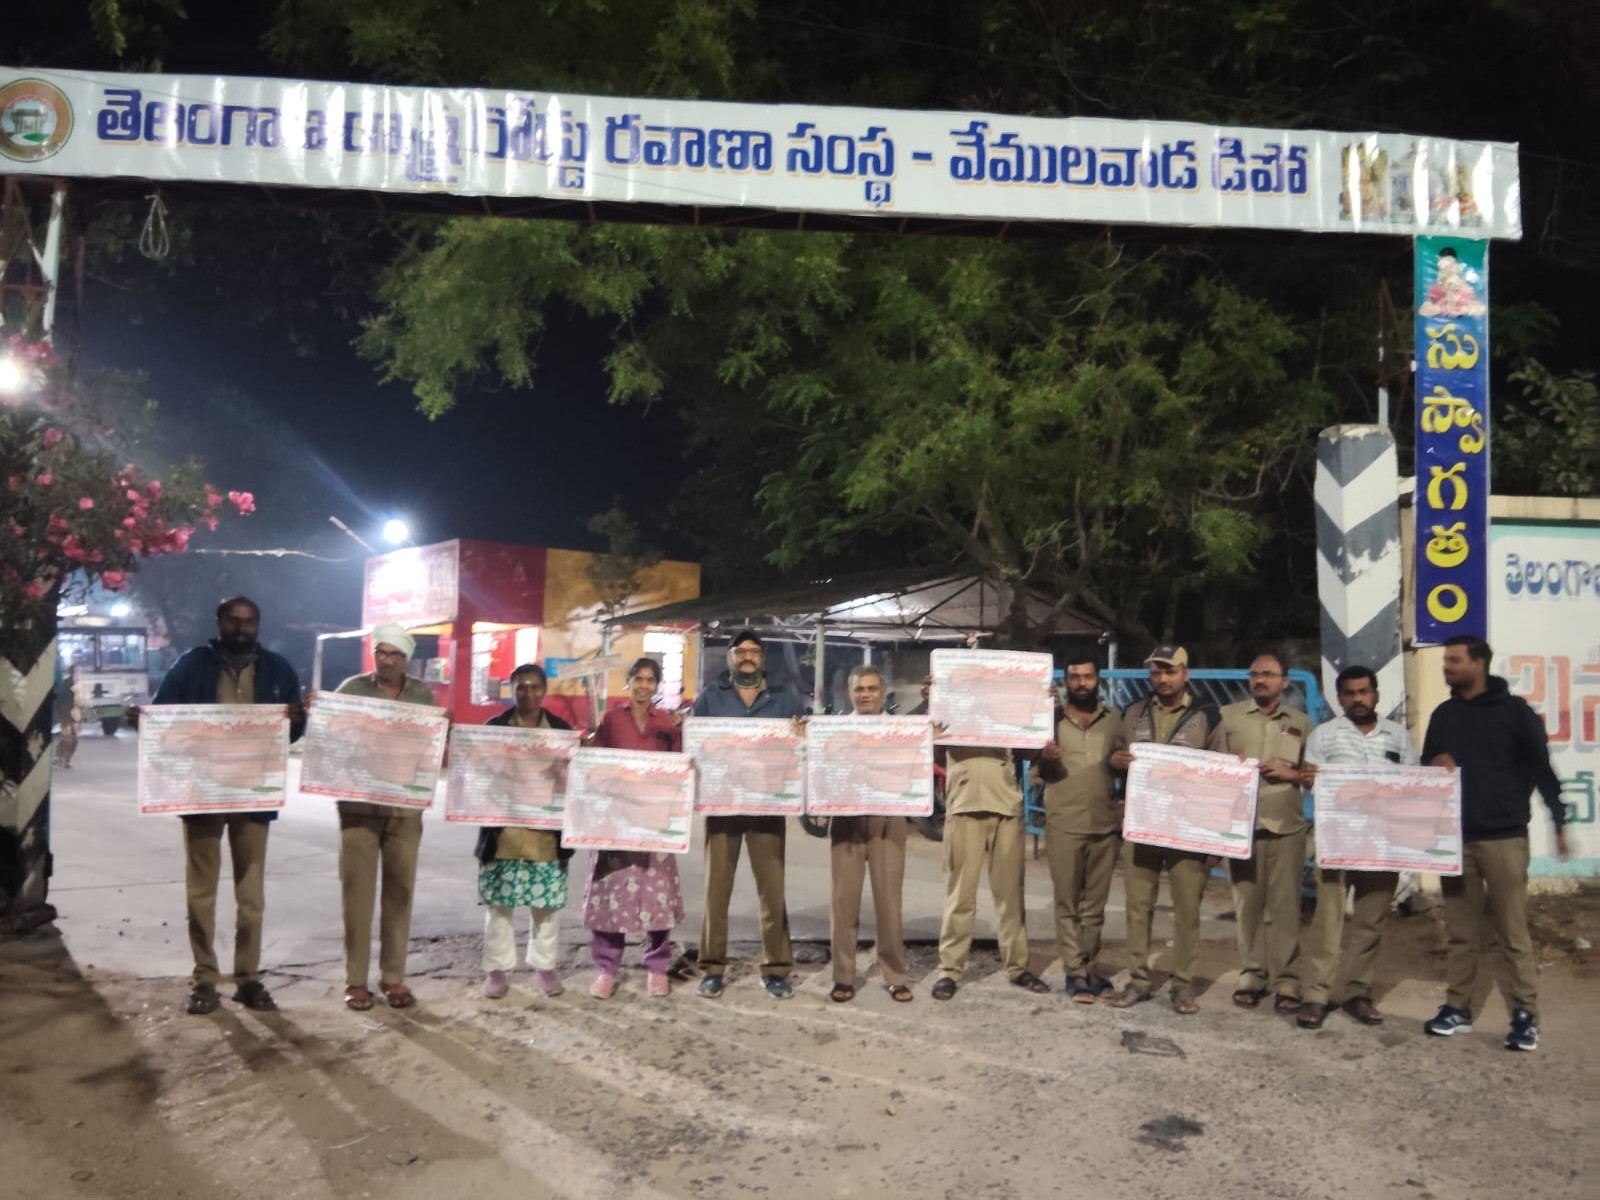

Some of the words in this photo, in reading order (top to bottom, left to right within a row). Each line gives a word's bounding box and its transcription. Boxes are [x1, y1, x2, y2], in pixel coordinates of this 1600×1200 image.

[604, 113, 773, 171] రవాణా
[786, 121, 896, 208] సంస్థ
[949, 120, 1199, 191] వేములవాడ
[1212, 136, 1309, 195] డిపో
[1505, 553, 1600, 598] తెలంగా
